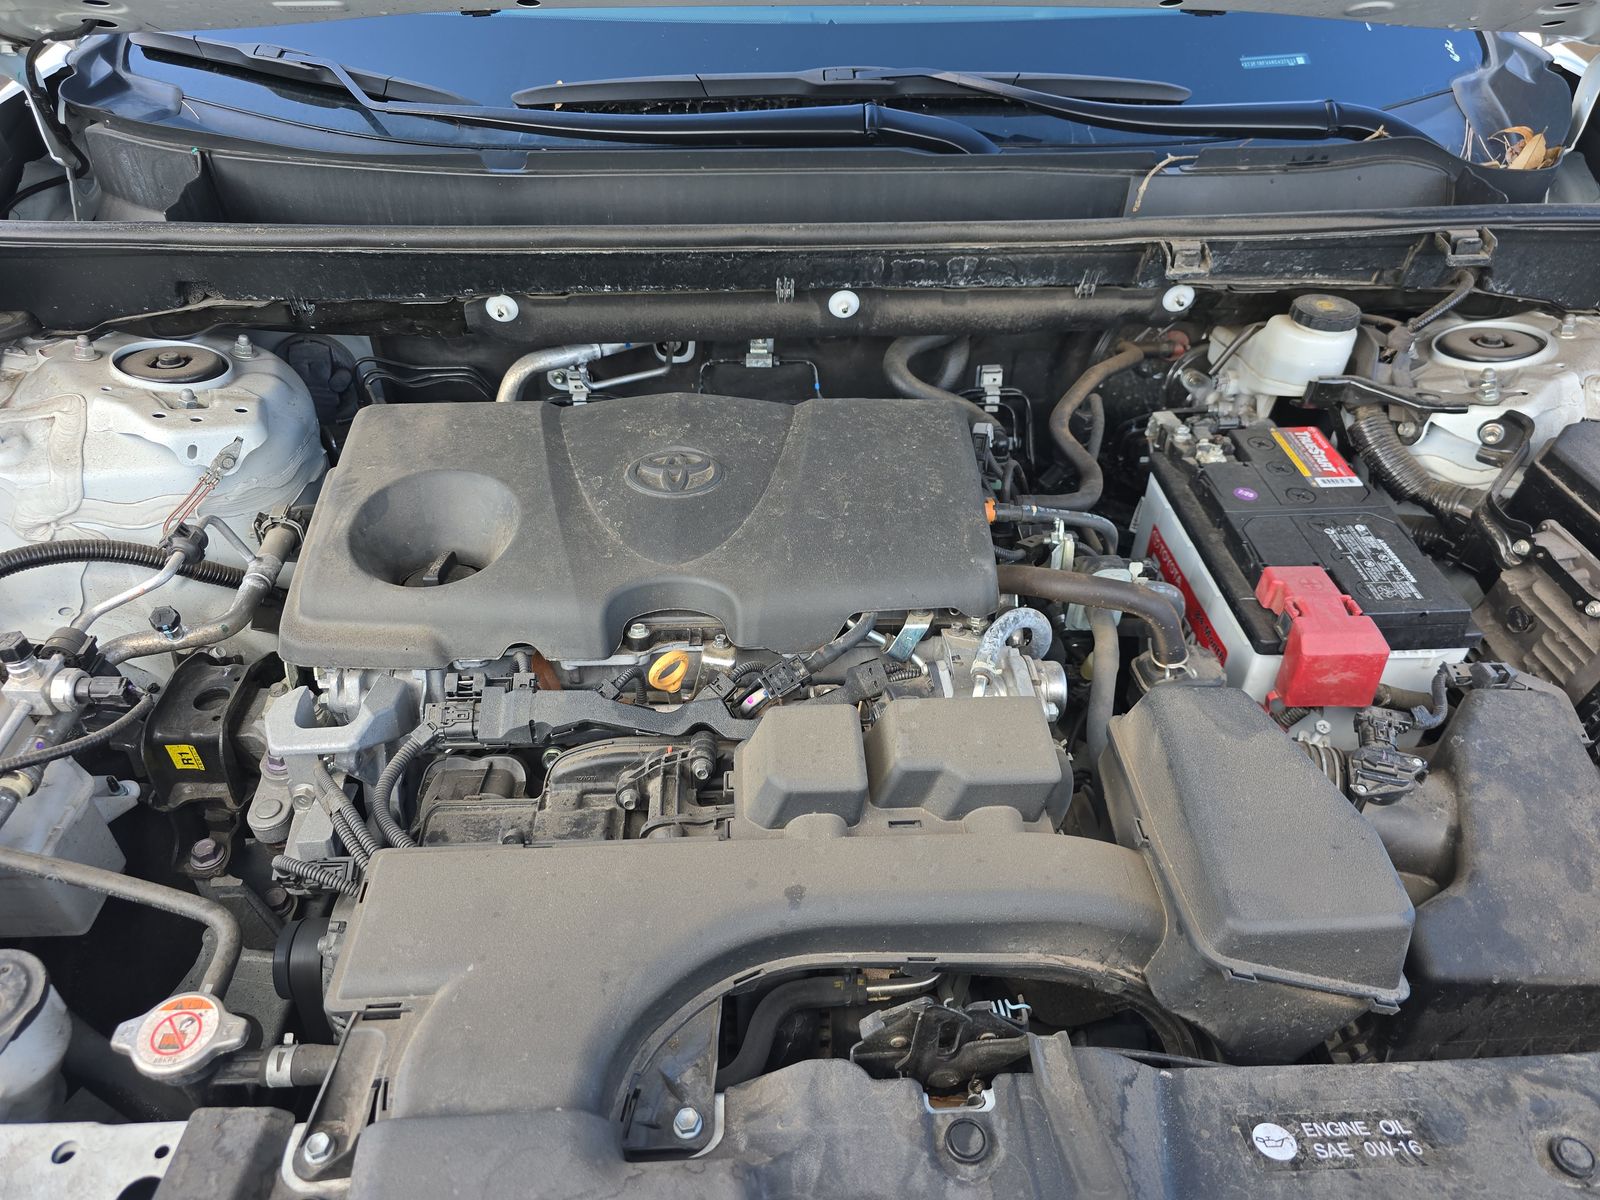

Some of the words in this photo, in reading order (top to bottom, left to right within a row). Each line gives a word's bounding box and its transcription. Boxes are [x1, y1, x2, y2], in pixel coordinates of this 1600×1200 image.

[177, 752, 195, 765] R1
[1300, 1120, 1371, 1137] ENGINE
[1379, 1119, 1413, 1136] OIL
[1313, 1142, 1355, 1159] SAE
[1363, 1140, 1424, 1157] 0W-16
